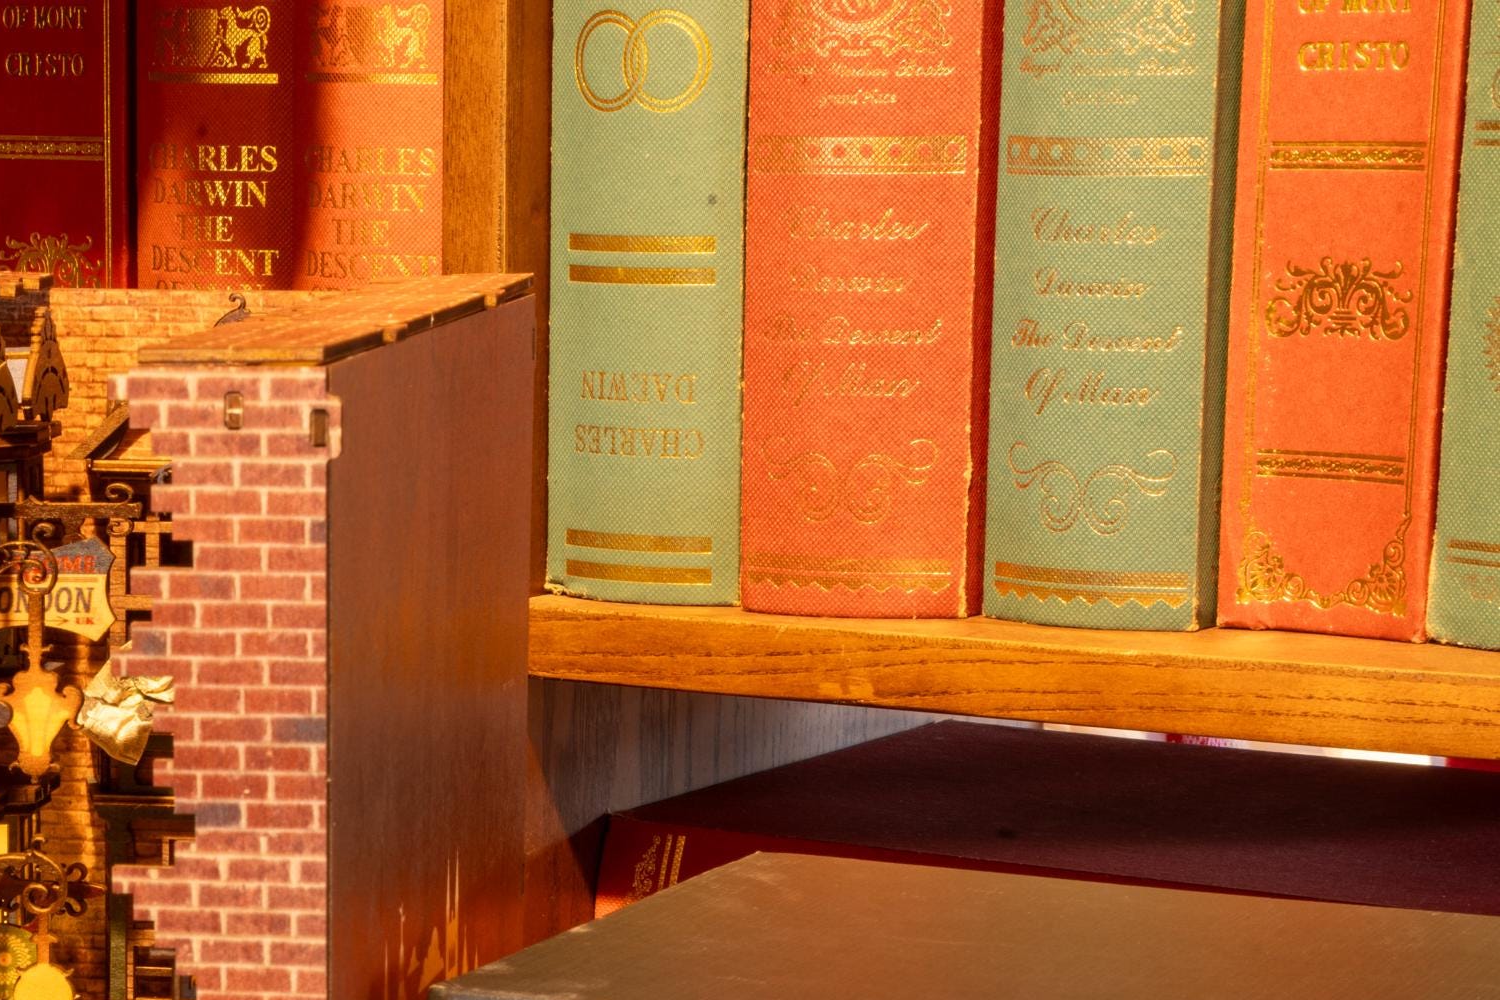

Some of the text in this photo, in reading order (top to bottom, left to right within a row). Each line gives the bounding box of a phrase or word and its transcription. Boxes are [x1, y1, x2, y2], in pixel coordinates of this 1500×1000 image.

[1298, 41, 1409, 71] CRISTO
[150, 144, 278, 172] CHARLES
[304, 146, 436, 177] CHARLES
[154, 177, 268, 208] DARWIN
[309, 181, 427, 213] DARWIN
[177, 215, 233, 242] THE
[332, 218, 389, 247] THE
[1031, 207, 1164, 244] Charles
[152, 245, 279, 277] DESCENT
[307, 252, 436, 279] DESCENT
[575, 423, 705, 459] CHARLES
